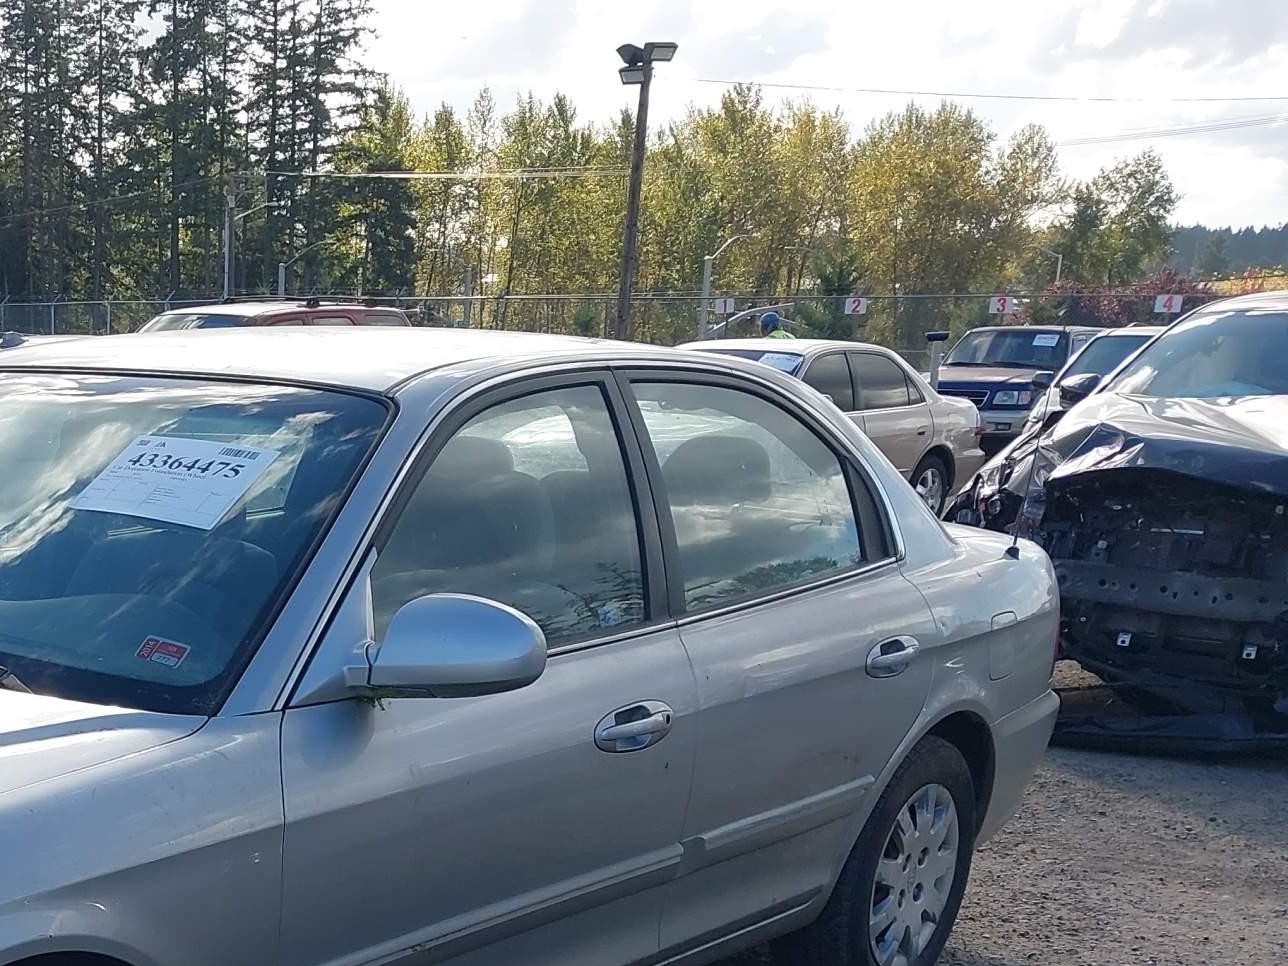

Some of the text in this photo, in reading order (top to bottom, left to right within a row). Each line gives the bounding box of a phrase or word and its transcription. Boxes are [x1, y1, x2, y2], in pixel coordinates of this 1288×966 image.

[851, 299, 861, 313] 2
[996, 297, 1007, 313] 3
[1162, 295, 1174, 312] 4
[128, 451, 246, 479] 43364475
